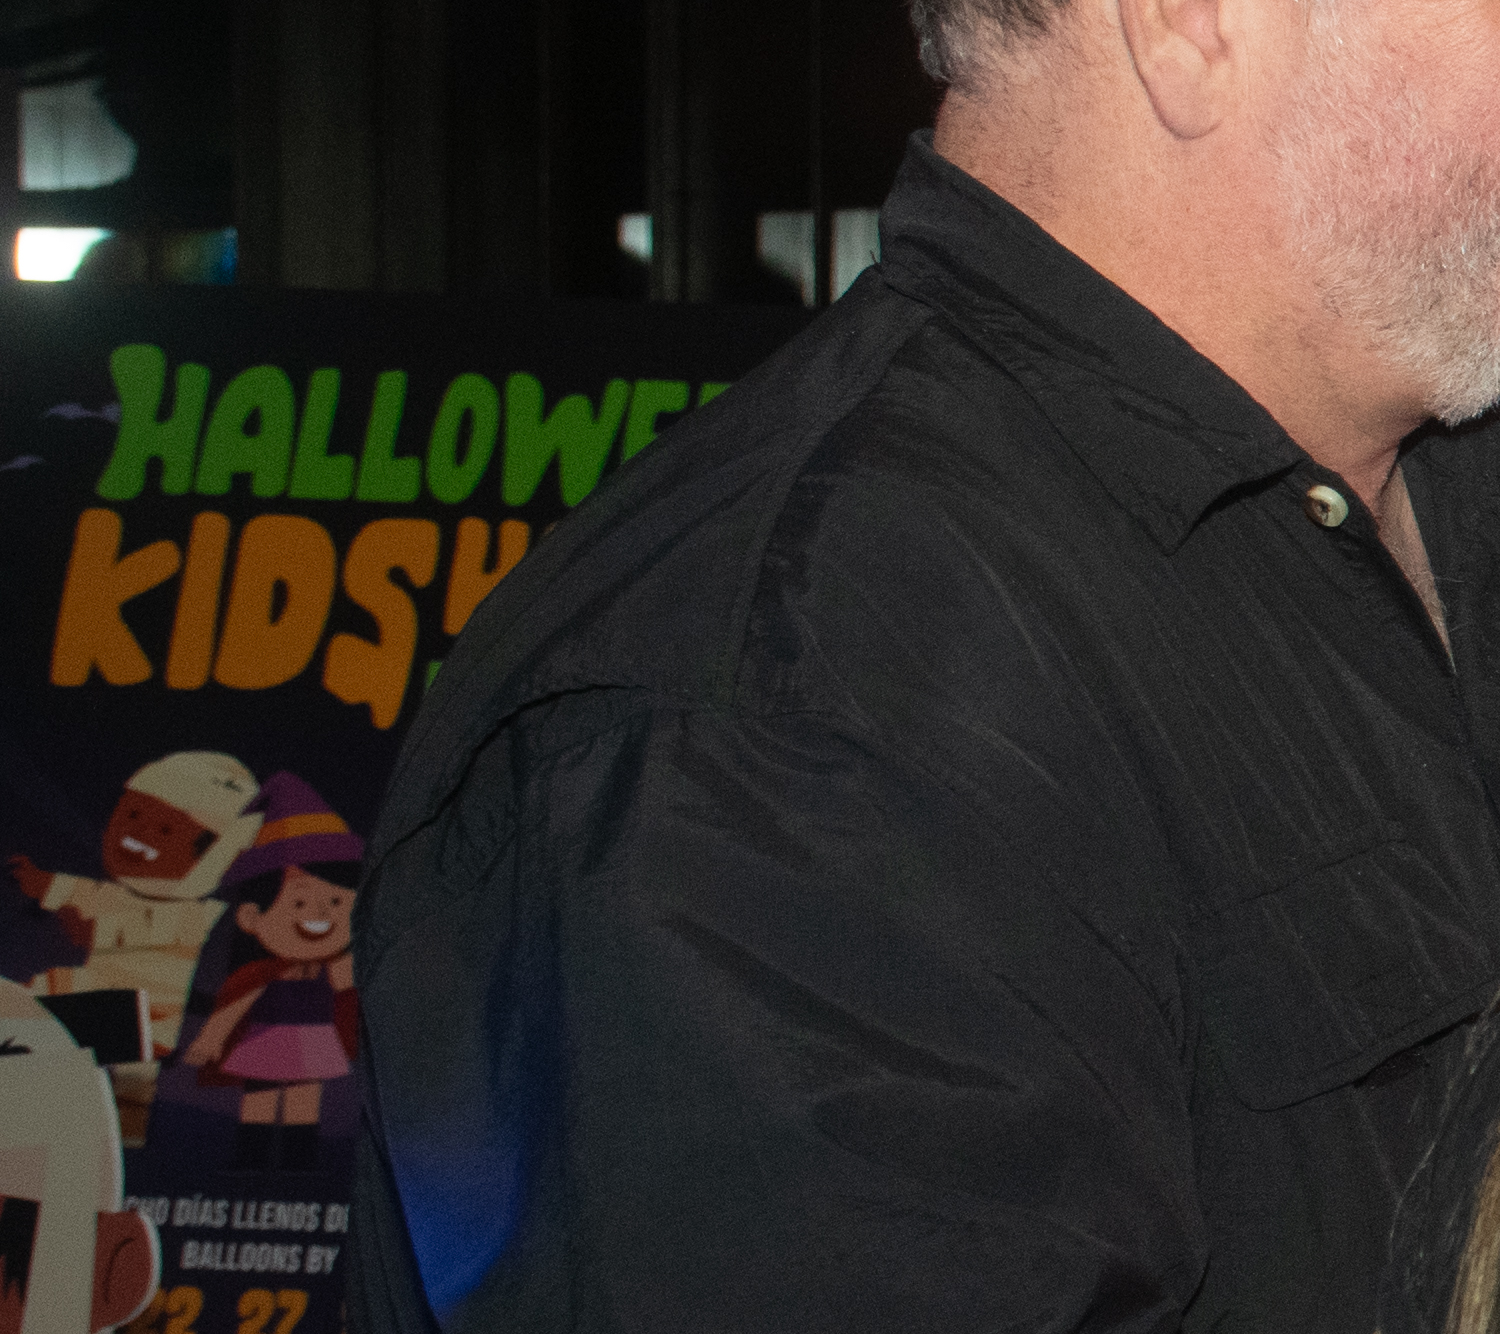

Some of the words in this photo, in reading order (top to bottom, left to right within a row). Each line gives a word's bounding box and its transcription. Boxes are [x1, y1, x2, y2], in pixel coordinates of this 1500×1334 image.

[95, 343, 735, 508] HALLOWE
[231, 1200, 322, 1233] LLENOS
[182, 1240, 303, 1273] BALLOONS
[305, 1244, 340, 1274] BY
